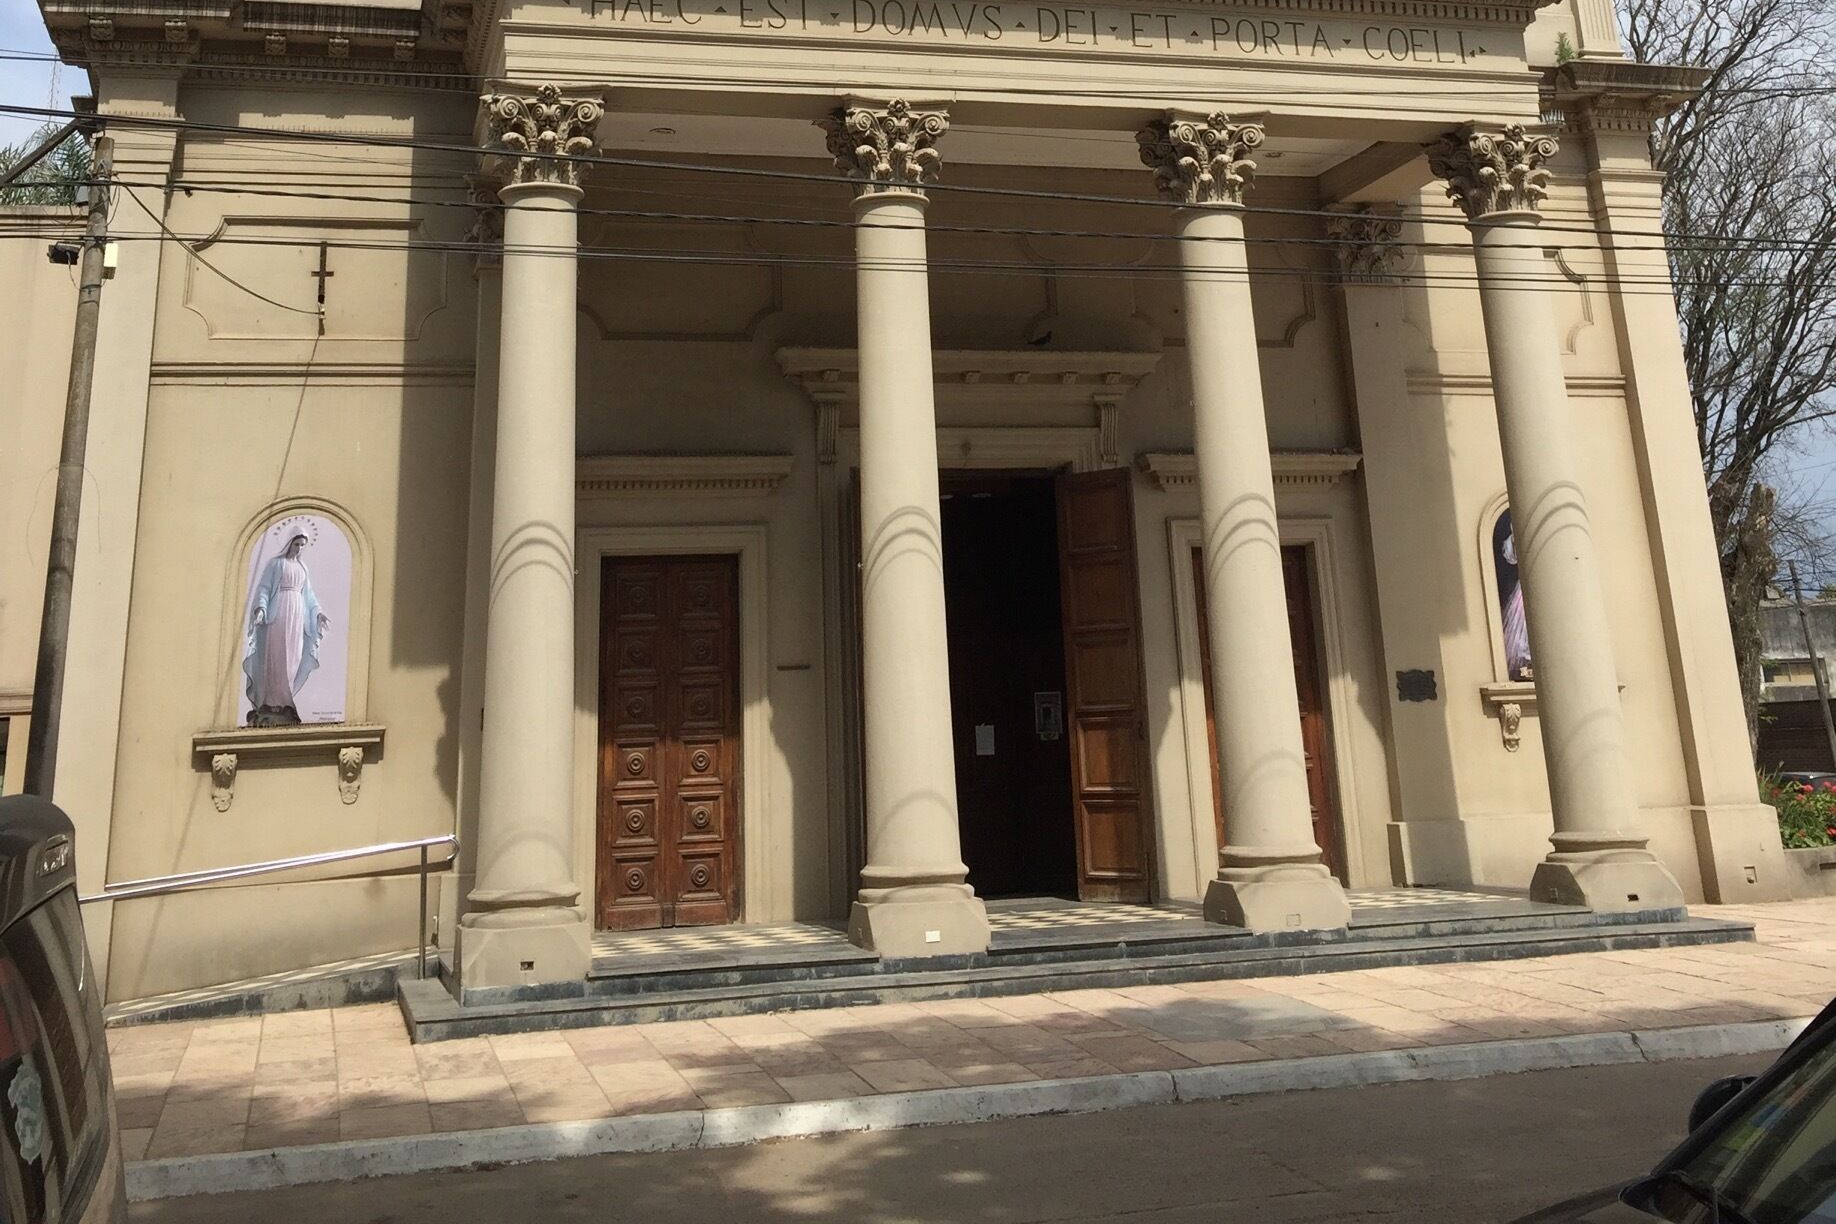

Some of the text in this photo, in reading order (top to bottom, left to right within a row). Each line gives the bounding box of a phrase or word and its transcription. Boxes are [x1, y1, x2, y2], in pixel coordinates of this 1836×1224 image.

[1037, 7, 1099, 46] DEI
[1130, 12, 1177, 49] ET
[1211, 17, 1334, 58] PORTA
[1362, 26, 1468, 65] COELI
